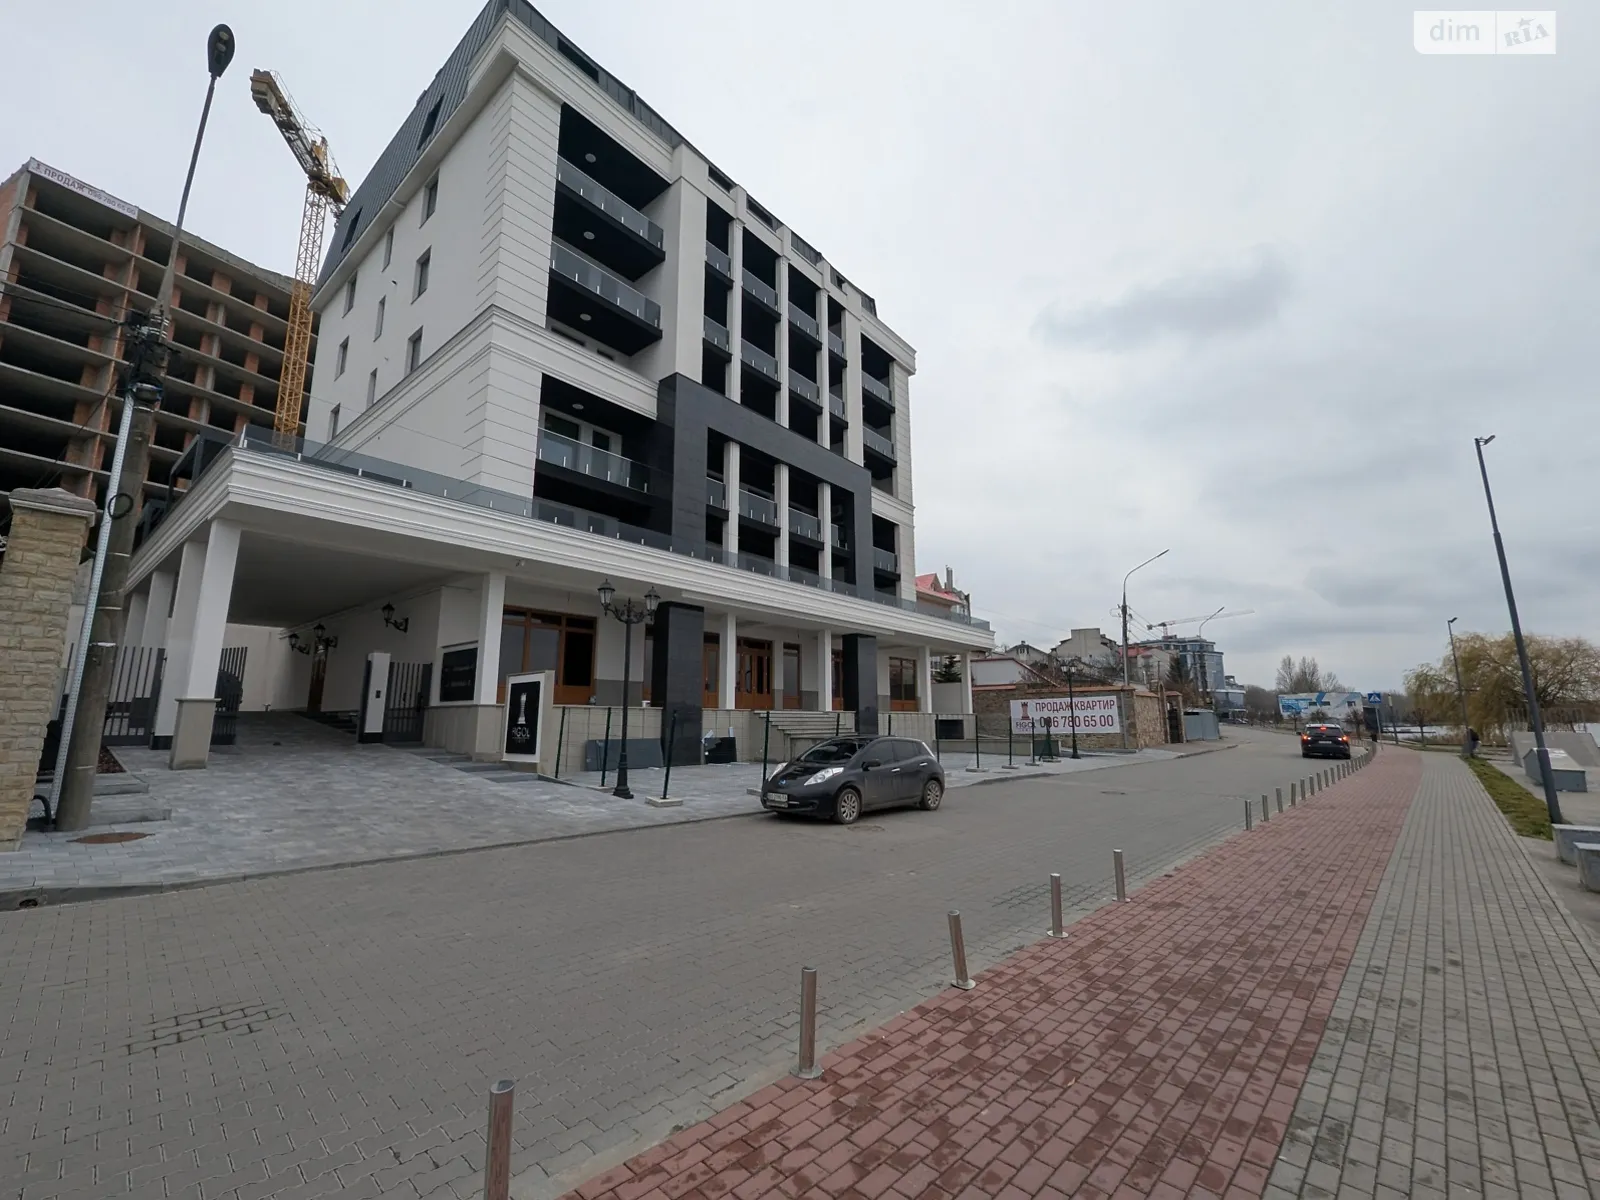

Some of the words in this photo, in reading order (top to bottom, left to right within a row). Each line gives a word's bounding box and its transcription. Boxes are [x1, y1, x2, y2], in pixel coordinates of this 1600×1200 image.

[44, 168, 86, 192] ПРОДАЖ
[1035, 702, 1072, 713] ПРОДАЖ
[1074, 700, 1115, 711] КВАРТИР
[1083, 715, 1097, 728] 65
[1099, 715, 1114, 727] 00
